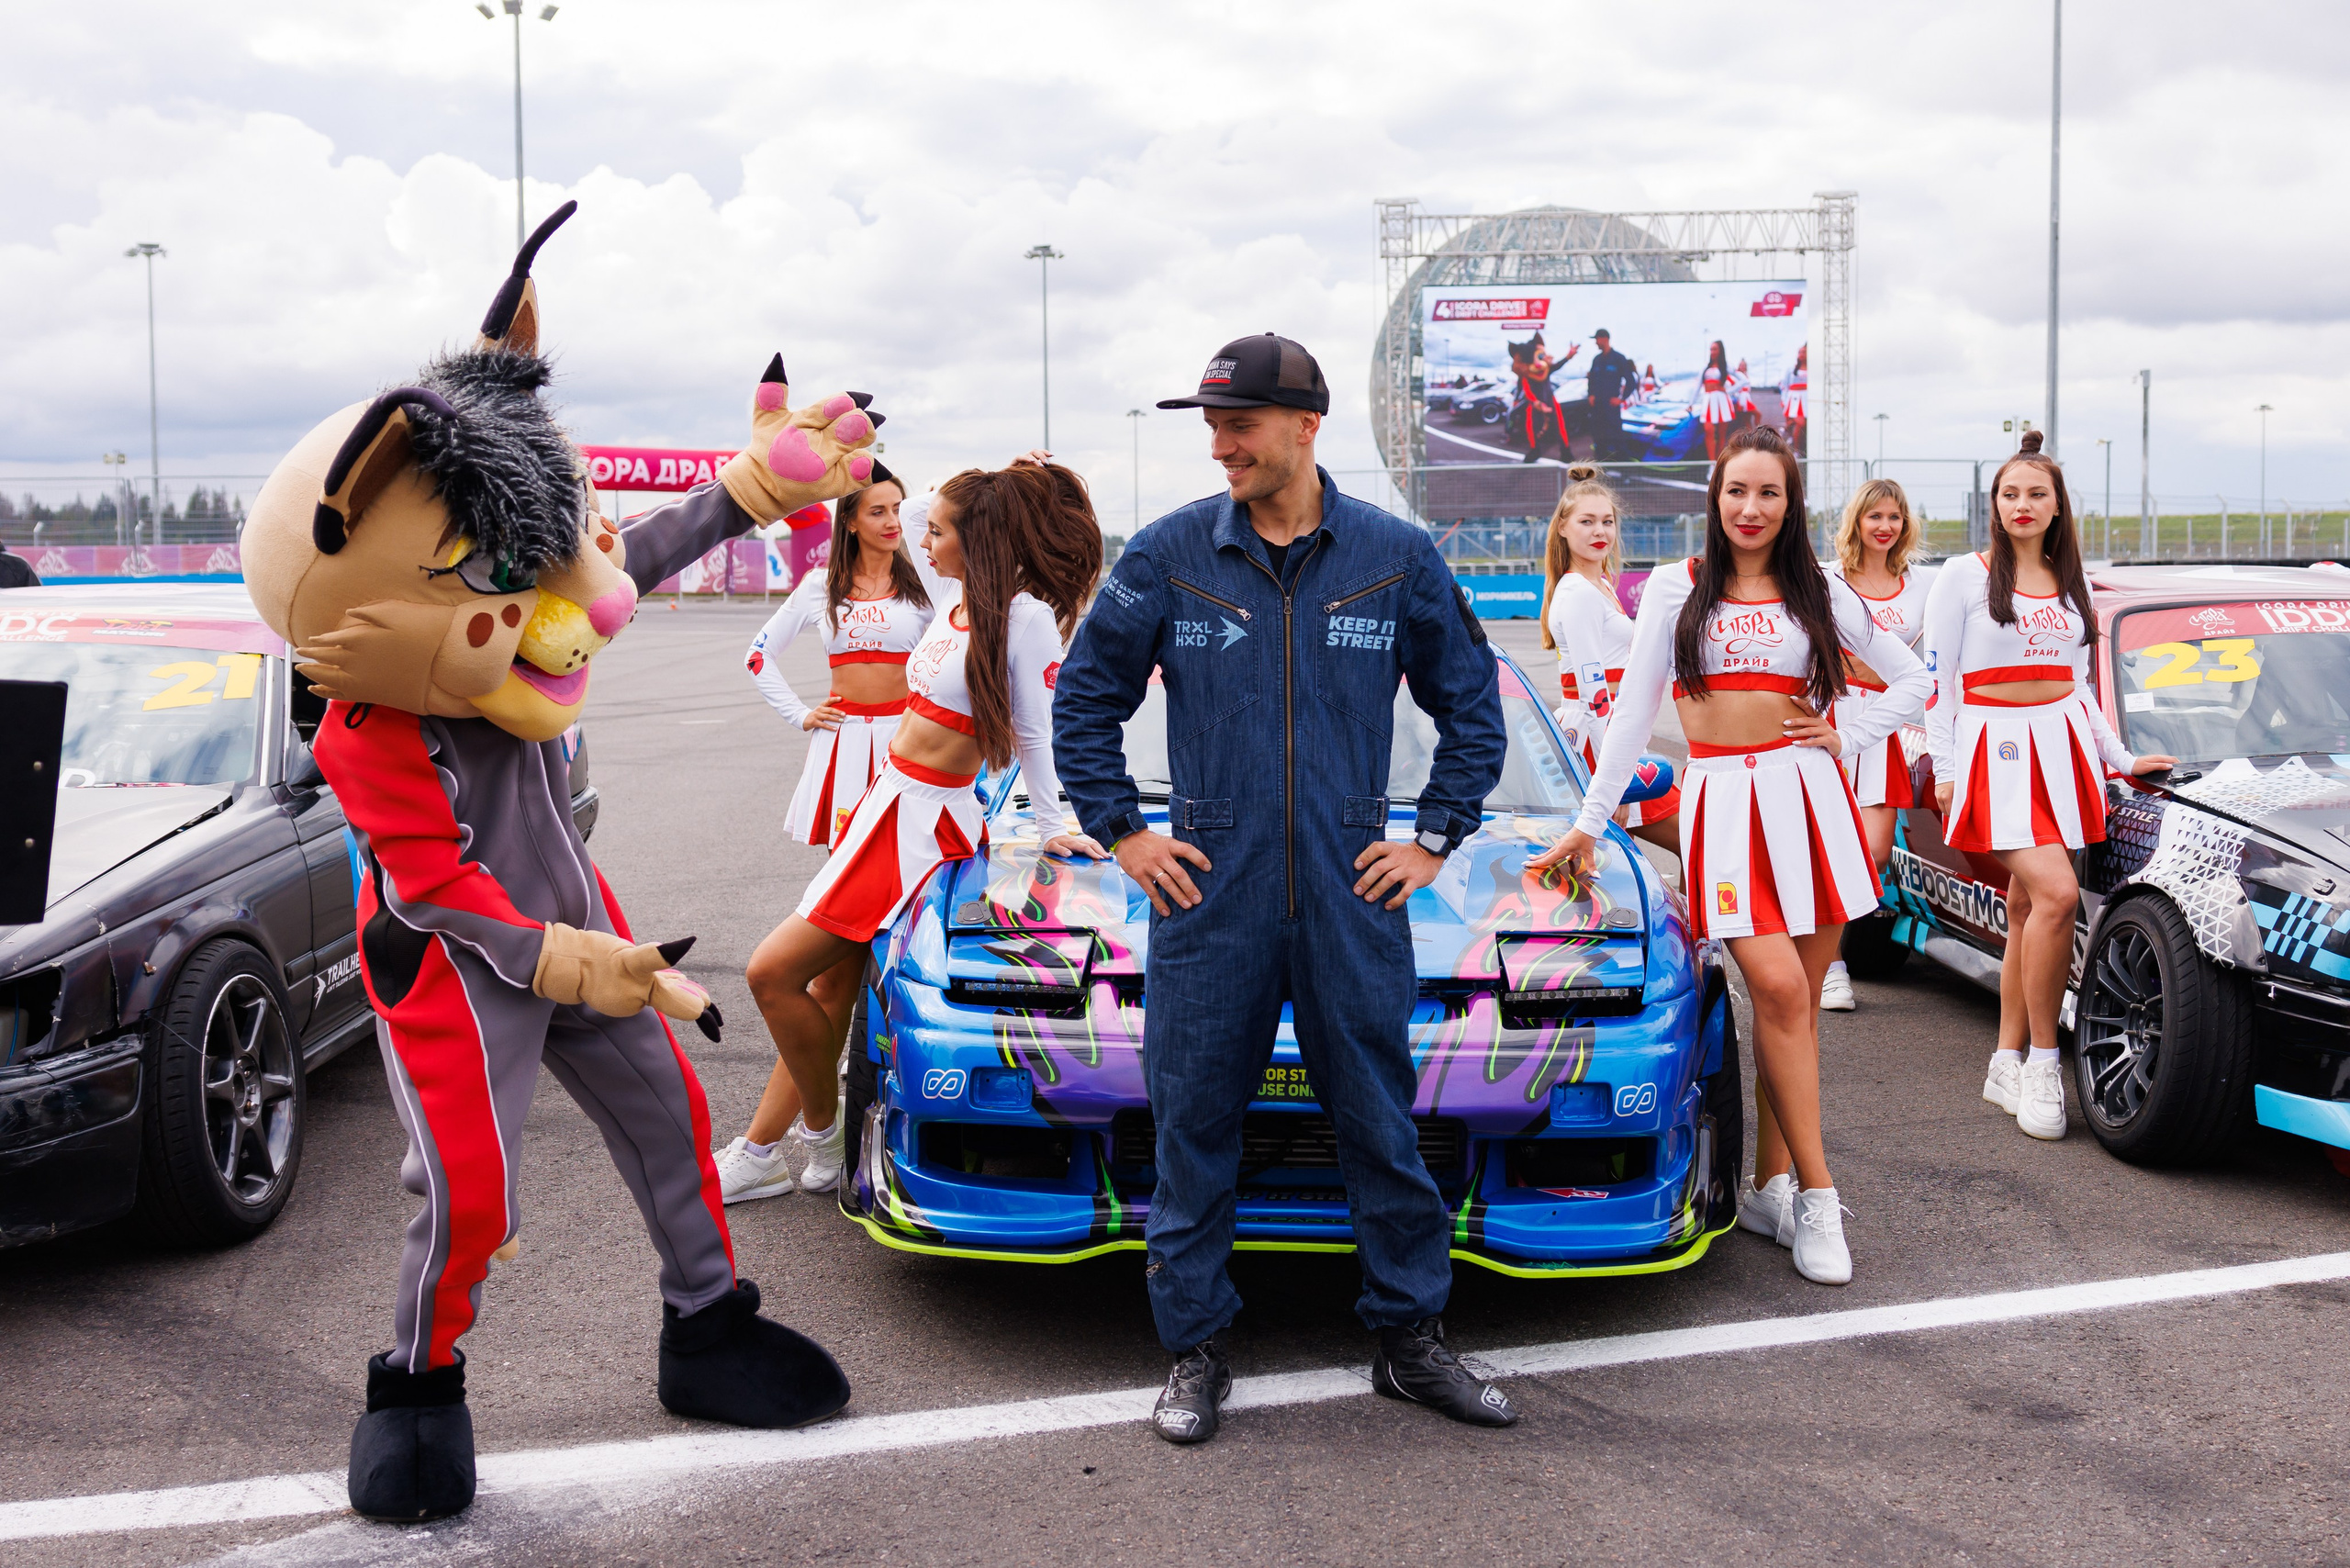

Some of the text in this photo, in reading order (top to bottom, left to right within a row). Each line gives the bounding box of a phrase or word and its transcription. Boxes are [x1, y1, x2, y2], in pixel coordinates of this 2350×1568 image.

[1220, 361, 1237, 370] SAYS
[1212, 370, 1232, 378] SPECIAL
[1116, 589, 1135, 603] RACE
[1119, 583, 1145, 601] GARAGE
[2255, 601, 2350, 610] IGORA DRI
[0, 615, 78, 635] DC
[1328, 615, 1396, 635] KEEP IT
[0, 633, 66, 642] ALLENGE
[848, 640, 883, 649] ДРАЙВ
[1326, 631, 1395, 651] STREET
[2024, 646, 2060, 657] ДРАЙВ
[1723, 656, 1770, 667] ДРАЙВ
[2141, 639, 2261, 689] 23
[141, 654, 262, 711] 21
[909, 675, 931, 694] ДРАЙВ
[2118, 807, 2158, 823] STYLE
[328, 951, 361, 986] TRAILHE
[1265, 1068, 1287, 1081] OR
[1258, 1083, 1285, 1096] USE
[1300, 1192, 1347, 1201] STR
[1485, 1385, 1505, 1406] OM
[1155, 1412, 1194, 1426] OMP
